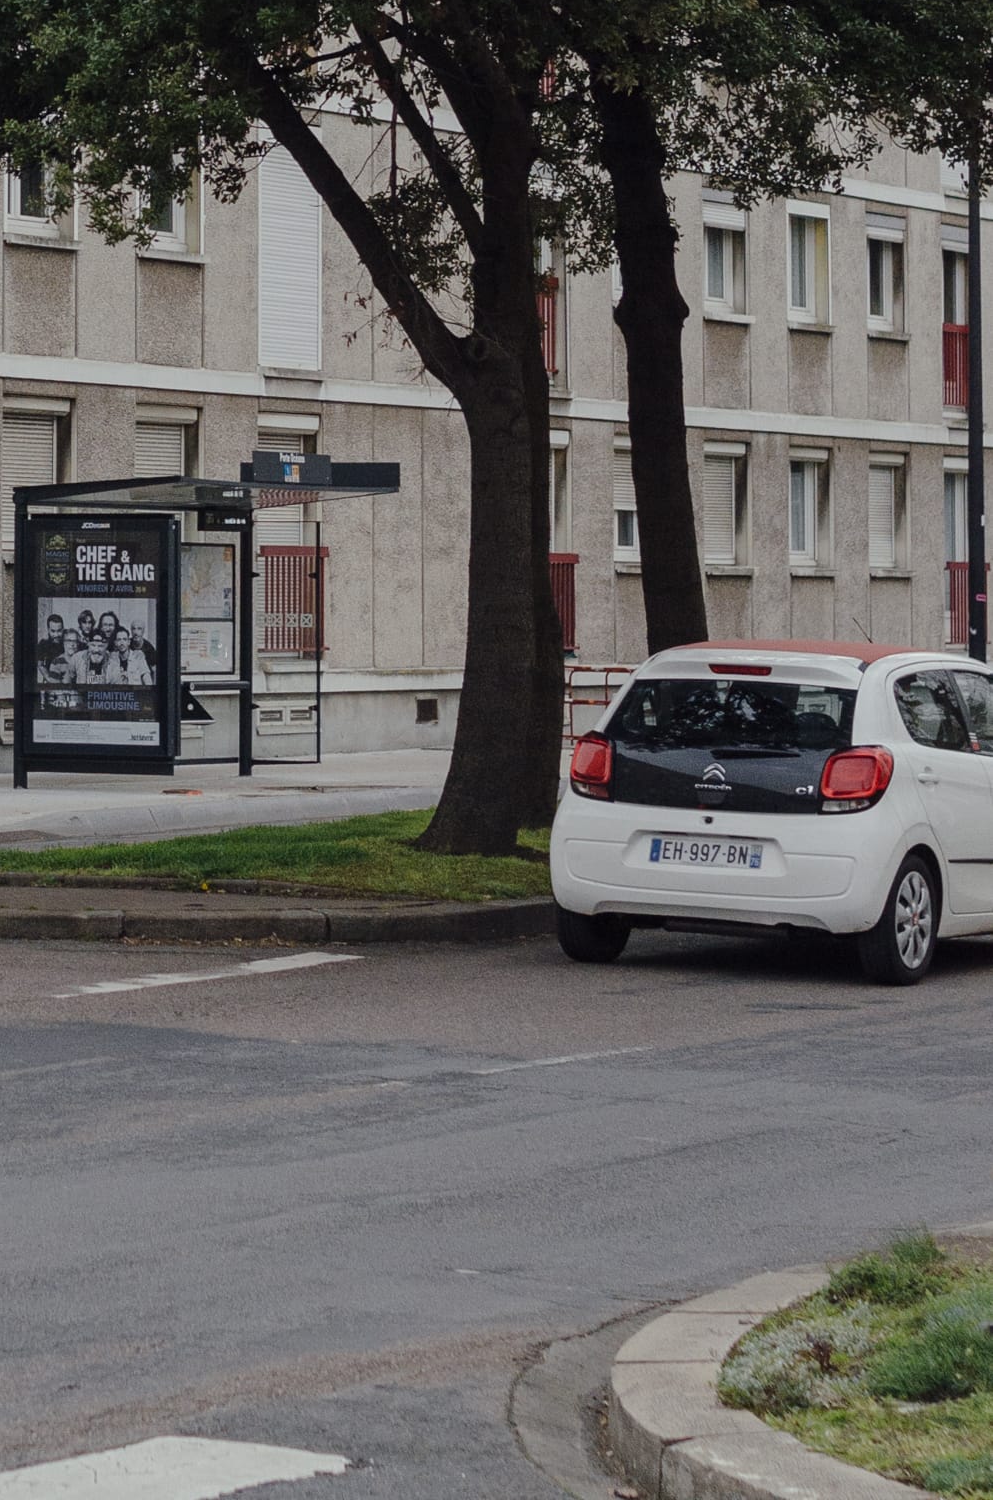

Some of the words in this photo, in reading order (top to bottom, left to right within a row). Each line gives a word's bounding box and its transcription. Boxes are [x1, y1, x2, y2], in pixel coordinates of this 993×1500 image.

[76, 545, 116, 563] CHEF
[121, 550, 130, 563] &
[75, 564, 106, 581] THE
[110, 564, 155, 581] GANG
[77, 583, 108, 593] VENDREDI
[110, 584, 114, 592] 7
[115, 584, 134, 593] AVRIL
[87, 691, 135, 701] PRIMITIVE
[87, 701, 140, 711] LIMOUSINE
[662, 841, 748, 864] EH-997-BN
